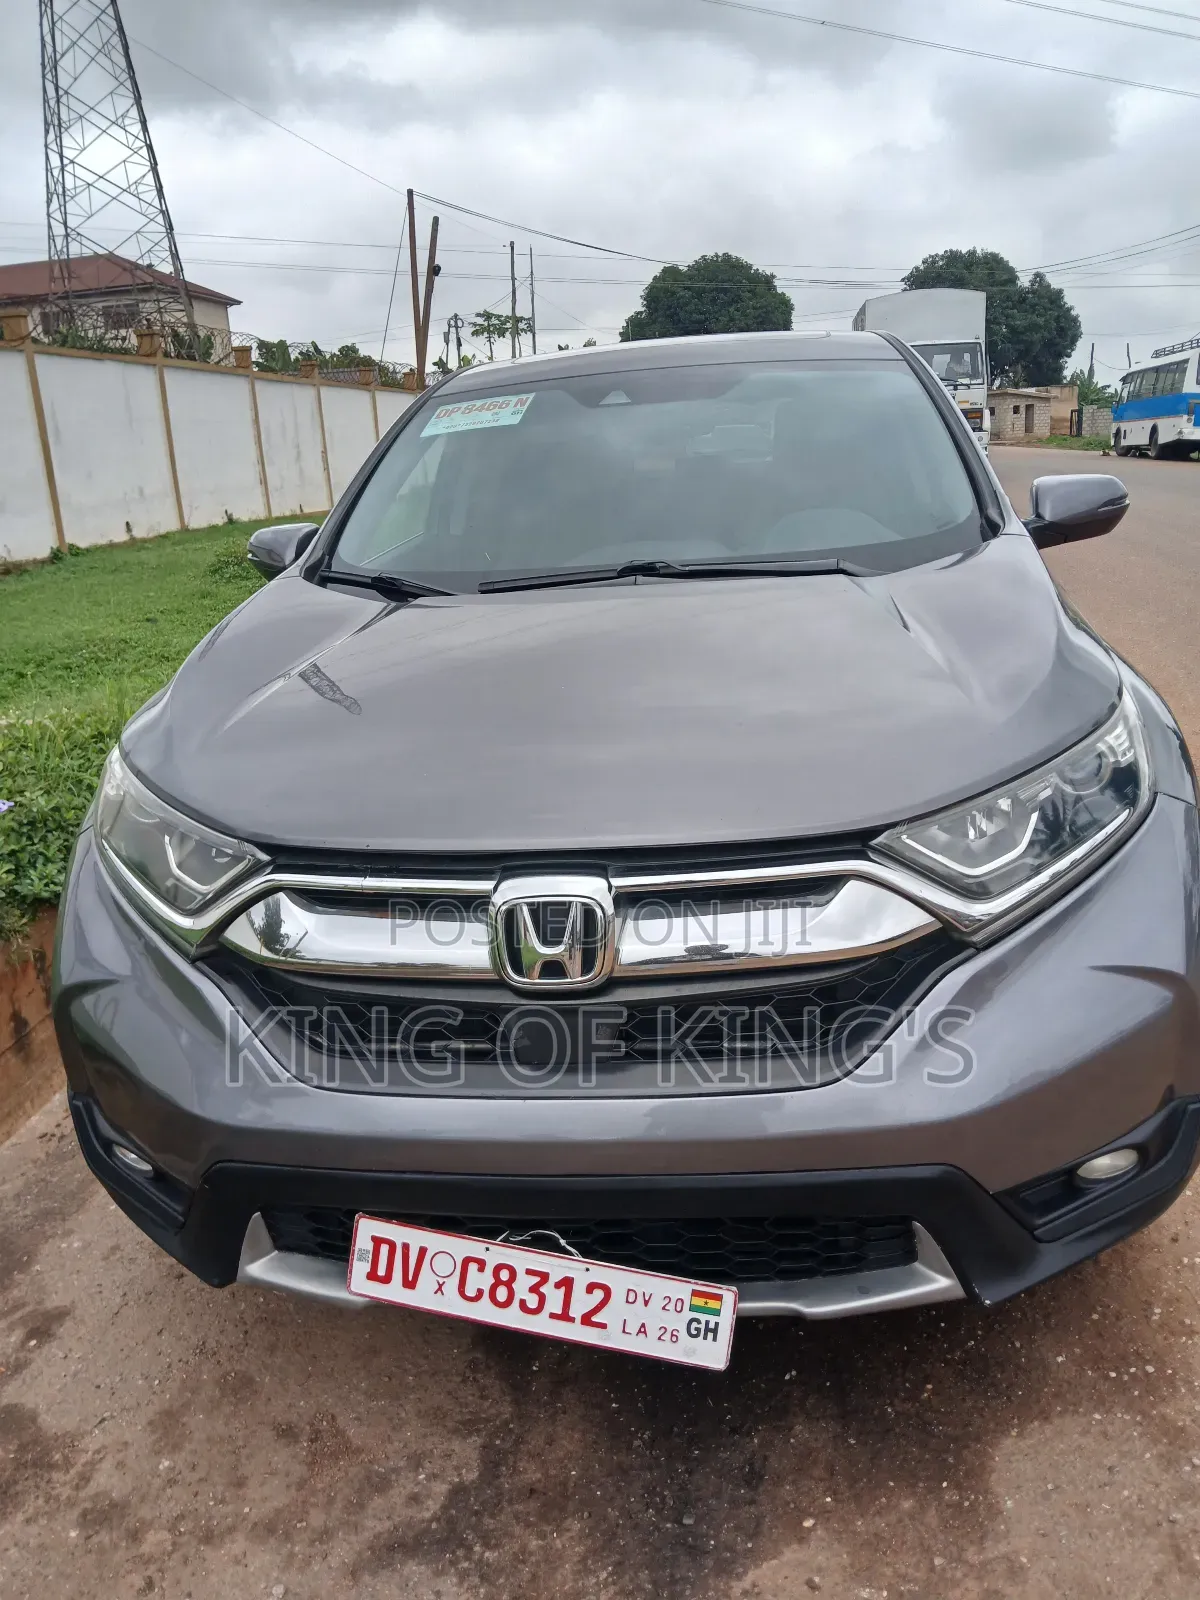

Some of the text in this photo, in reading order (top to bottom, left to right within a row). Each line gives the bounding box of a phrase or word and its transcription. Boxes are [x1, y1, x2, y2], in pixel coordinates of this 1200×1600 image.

[434, 406, 461, 420] DP
[513, 396, 531, 409] N
[366, 1235, 613, 1330] DV C8312
[625, 1288, 685, 1314] DV 20
[621, 1318, 680, 1343] LA 26
[686, 1317, 720, 1342] GH
